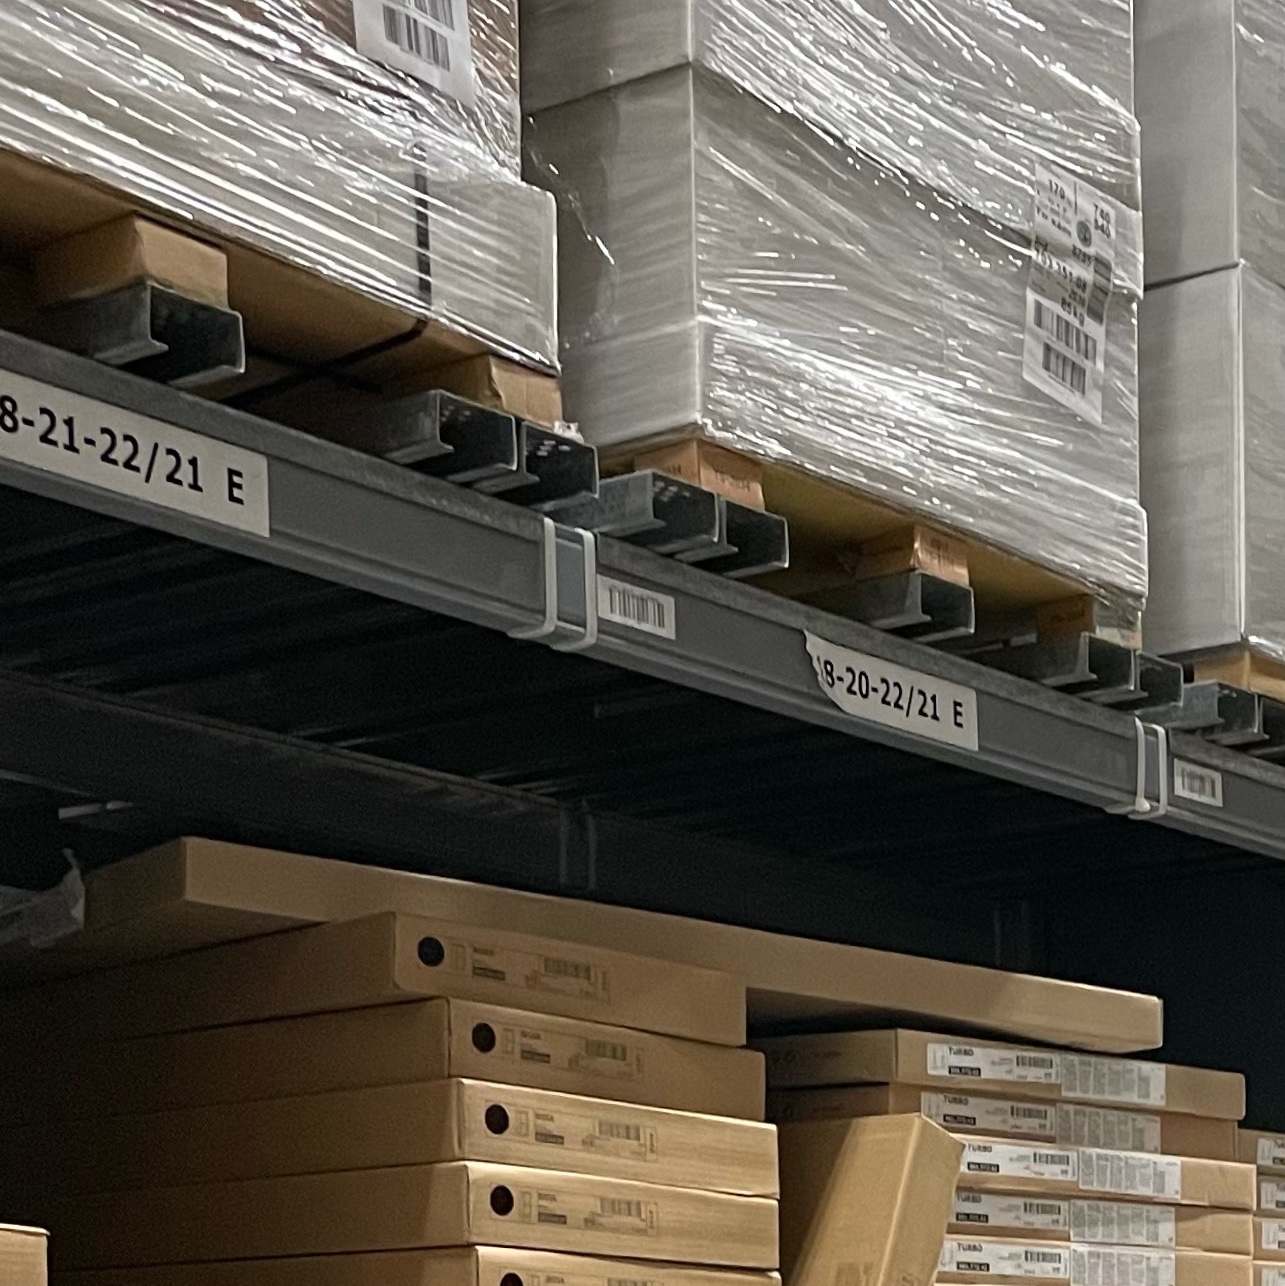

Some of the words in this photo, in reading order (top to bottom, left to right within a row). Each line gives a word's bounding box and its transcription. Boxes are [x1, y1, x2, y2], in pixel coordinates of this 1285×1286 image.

[0, 395, 204, 493] 8-21-22/21
[227, 467, 245, 506] E
[953, 700, 964, 729] E
[948, 1046, 974, 1057] TURBO
[967, 1143, 993, 1153] TURBO
[956, 1242, 983, 1252] TURBO
